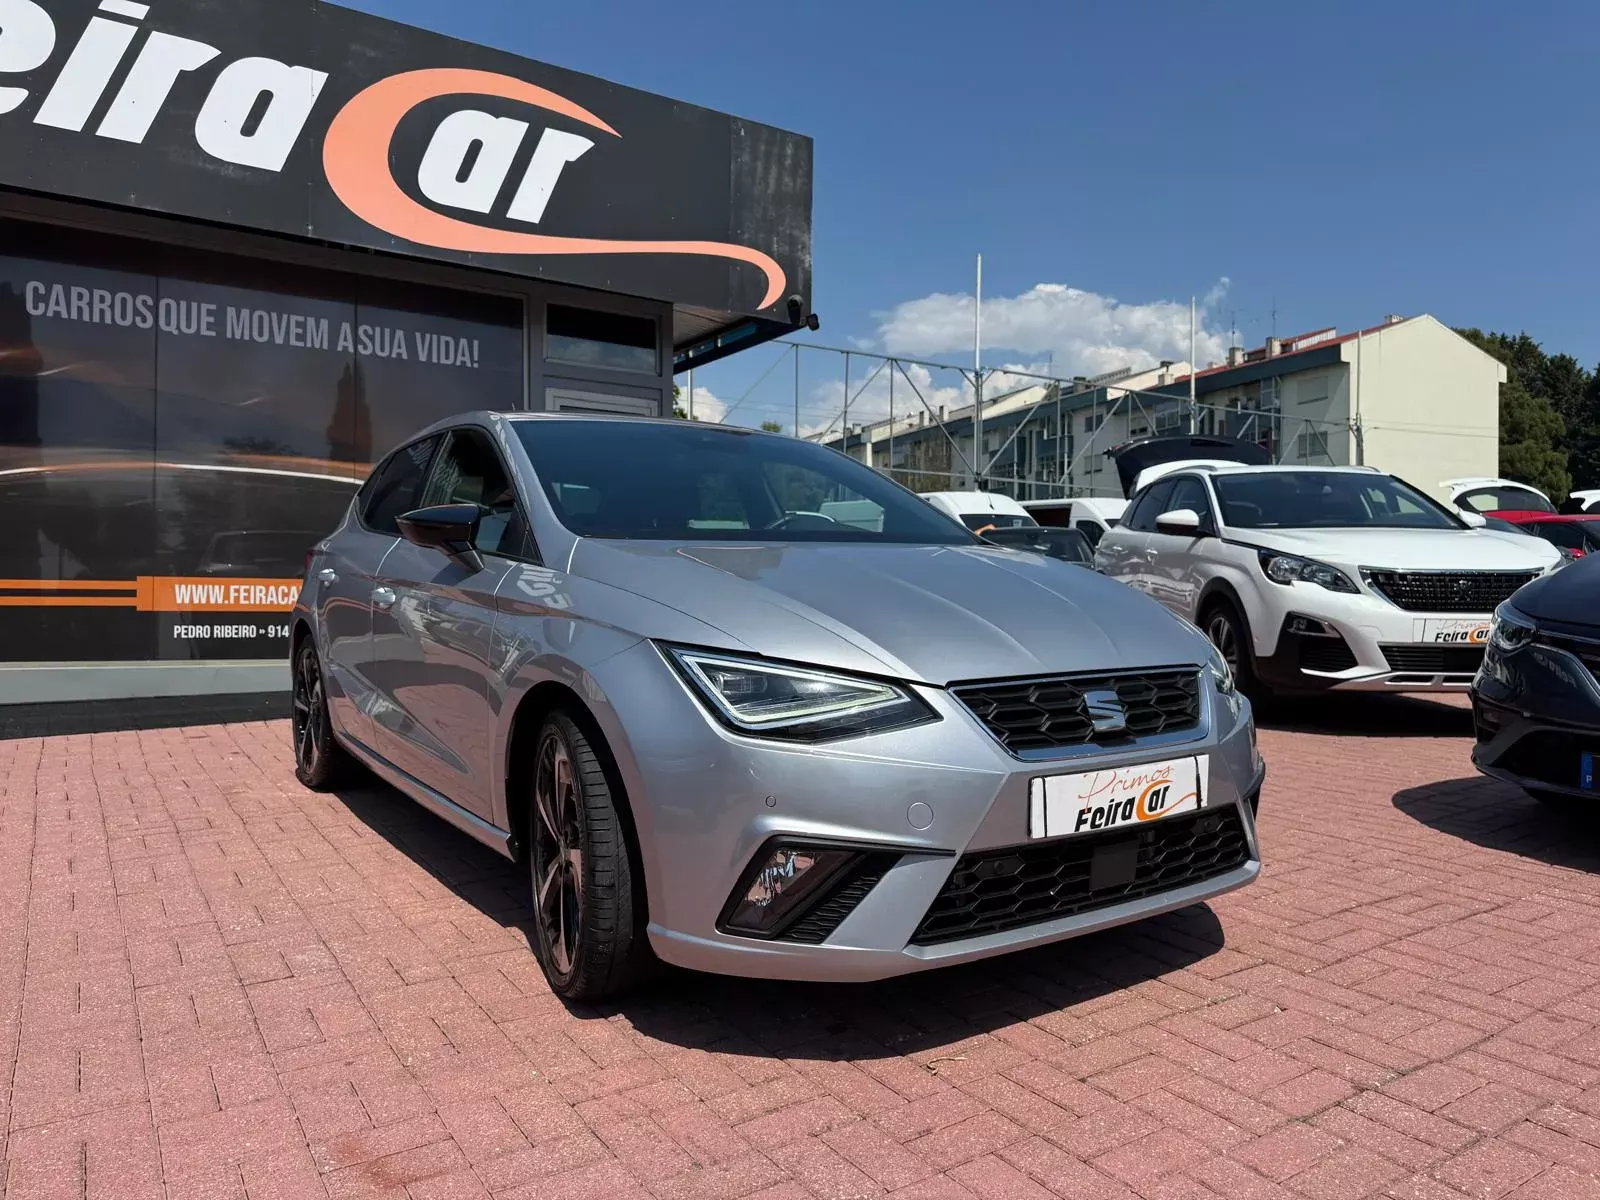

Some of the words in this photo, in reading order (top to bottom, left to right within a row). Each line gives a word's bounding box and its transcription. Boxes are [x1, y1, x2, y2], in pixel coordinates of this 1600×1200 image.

[25, 280, 154, 329] CARROS
[158, 297, 217, 337] QUE
[226, 306, 328, 350] MOVEM
[337, 322, 355, 353] A
[357, 322, 408, 360] SUA
[415, 332, 479, 368] VIDA!
[174, 625, 210, 638] PEDRO
[214, 625, 257, 638] RIBEIRO
[268, 625, 289, 638] 914
[1078, 764, 1174, 814] Primos
